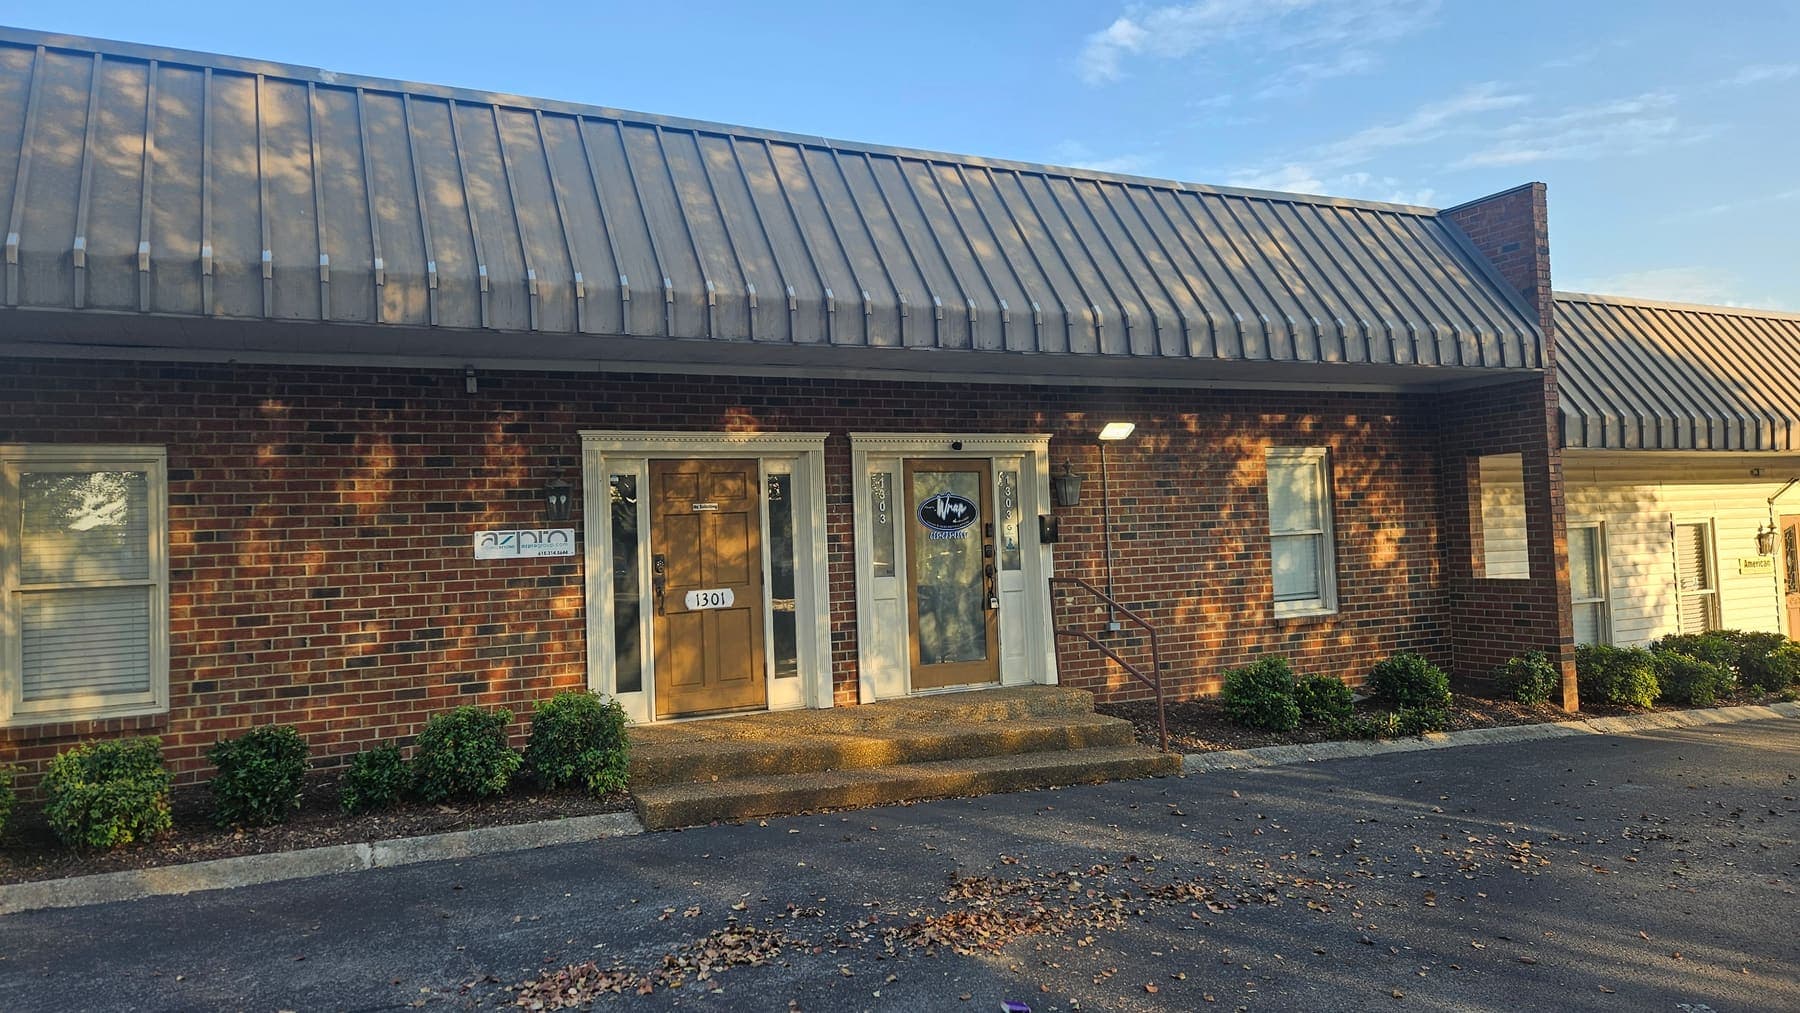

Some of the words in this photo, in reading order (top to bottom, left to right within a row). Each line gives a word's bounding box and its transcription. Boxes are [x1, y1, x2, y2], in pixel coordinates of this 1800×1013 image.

[1004, 475, 1013, 520] 1303
[937, 496, 967, 521] Wrap
[1744, 559, 1770, 568] American
[695, 592, 725, 607] 1301
